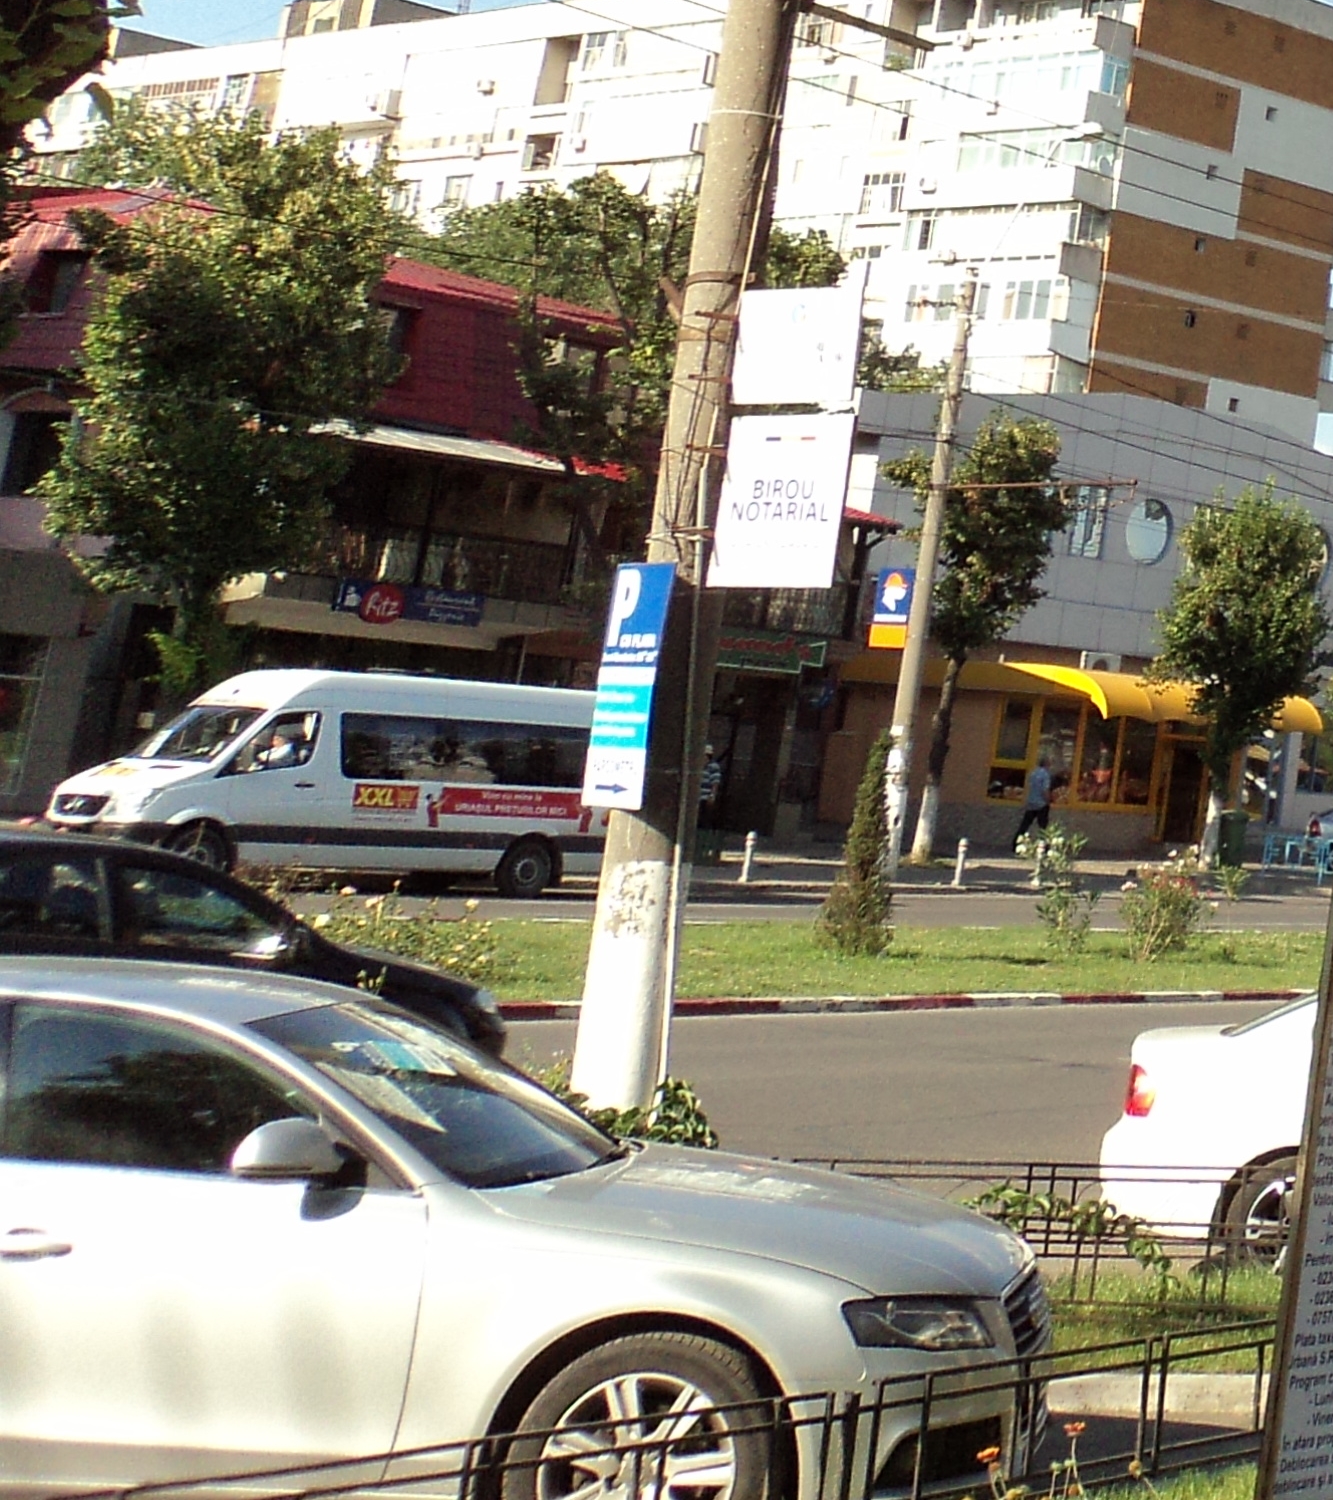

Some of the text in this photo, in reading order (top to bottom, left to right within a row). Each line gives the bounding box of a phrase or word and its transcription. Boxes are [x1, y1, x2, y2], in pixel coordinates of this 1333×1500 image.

[753, 480, 814, 499] BIROU
[731, 501, 829, 522] NOTARIAL
[608, 568, 642, 648] P
[354, 786, 395, 807] XXL
